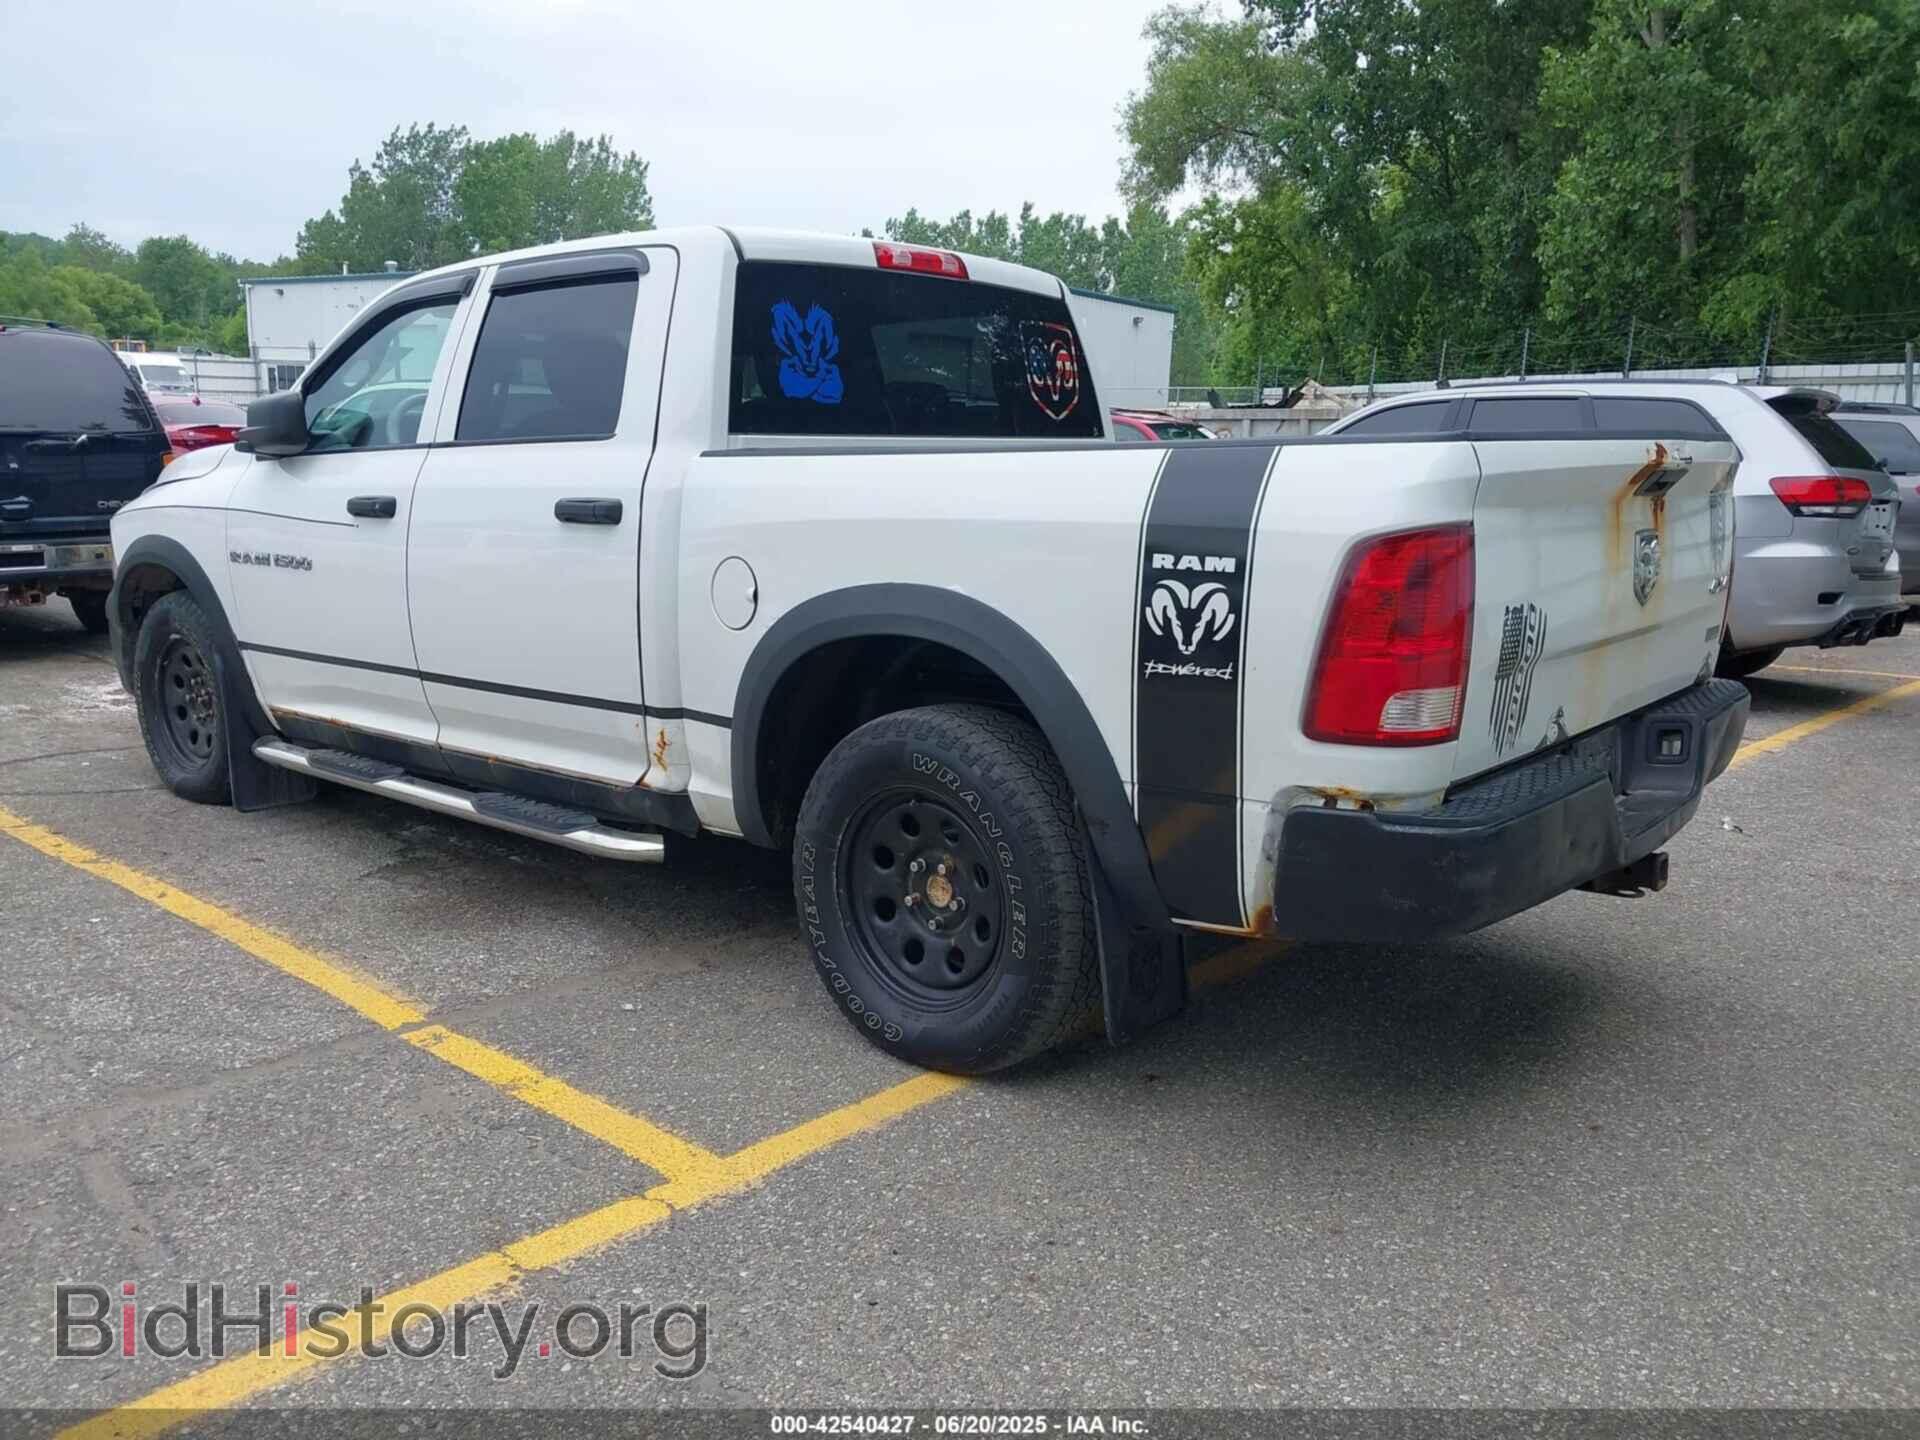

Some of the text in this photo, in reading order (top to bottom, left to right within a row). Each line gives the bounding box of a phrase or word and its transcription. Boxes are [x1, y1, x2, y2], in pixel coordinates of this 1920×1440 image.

[229, 551, 271, 567] RAM
[1152, 553, 1236, 573] RAM
[912, 753, 1028, 960] WRANGLER
[801, 842, 903, 1042] GOODYEAR
